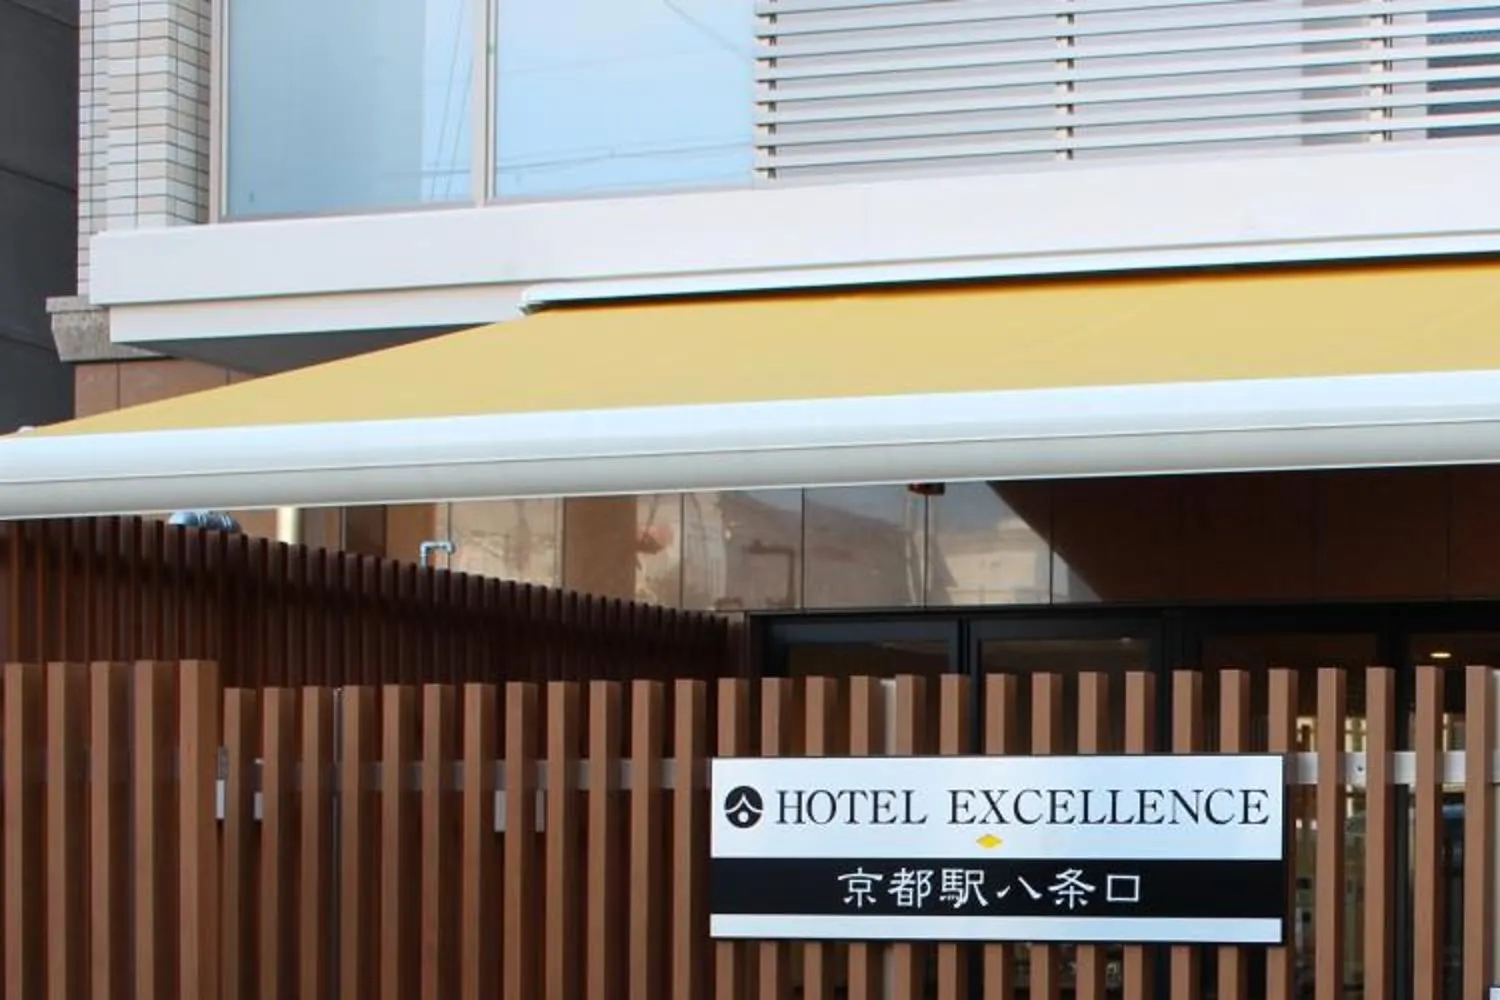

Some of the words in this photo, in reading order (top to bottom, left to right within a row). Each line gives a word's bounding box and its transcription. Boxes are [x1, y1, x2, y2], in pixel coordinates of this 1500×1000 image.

[775, 788, 928, 826] HOTEL
[946, 788, 1271, 826] EXCELLENCE
[836, 866, 1141, 910] 京都駅八条口
